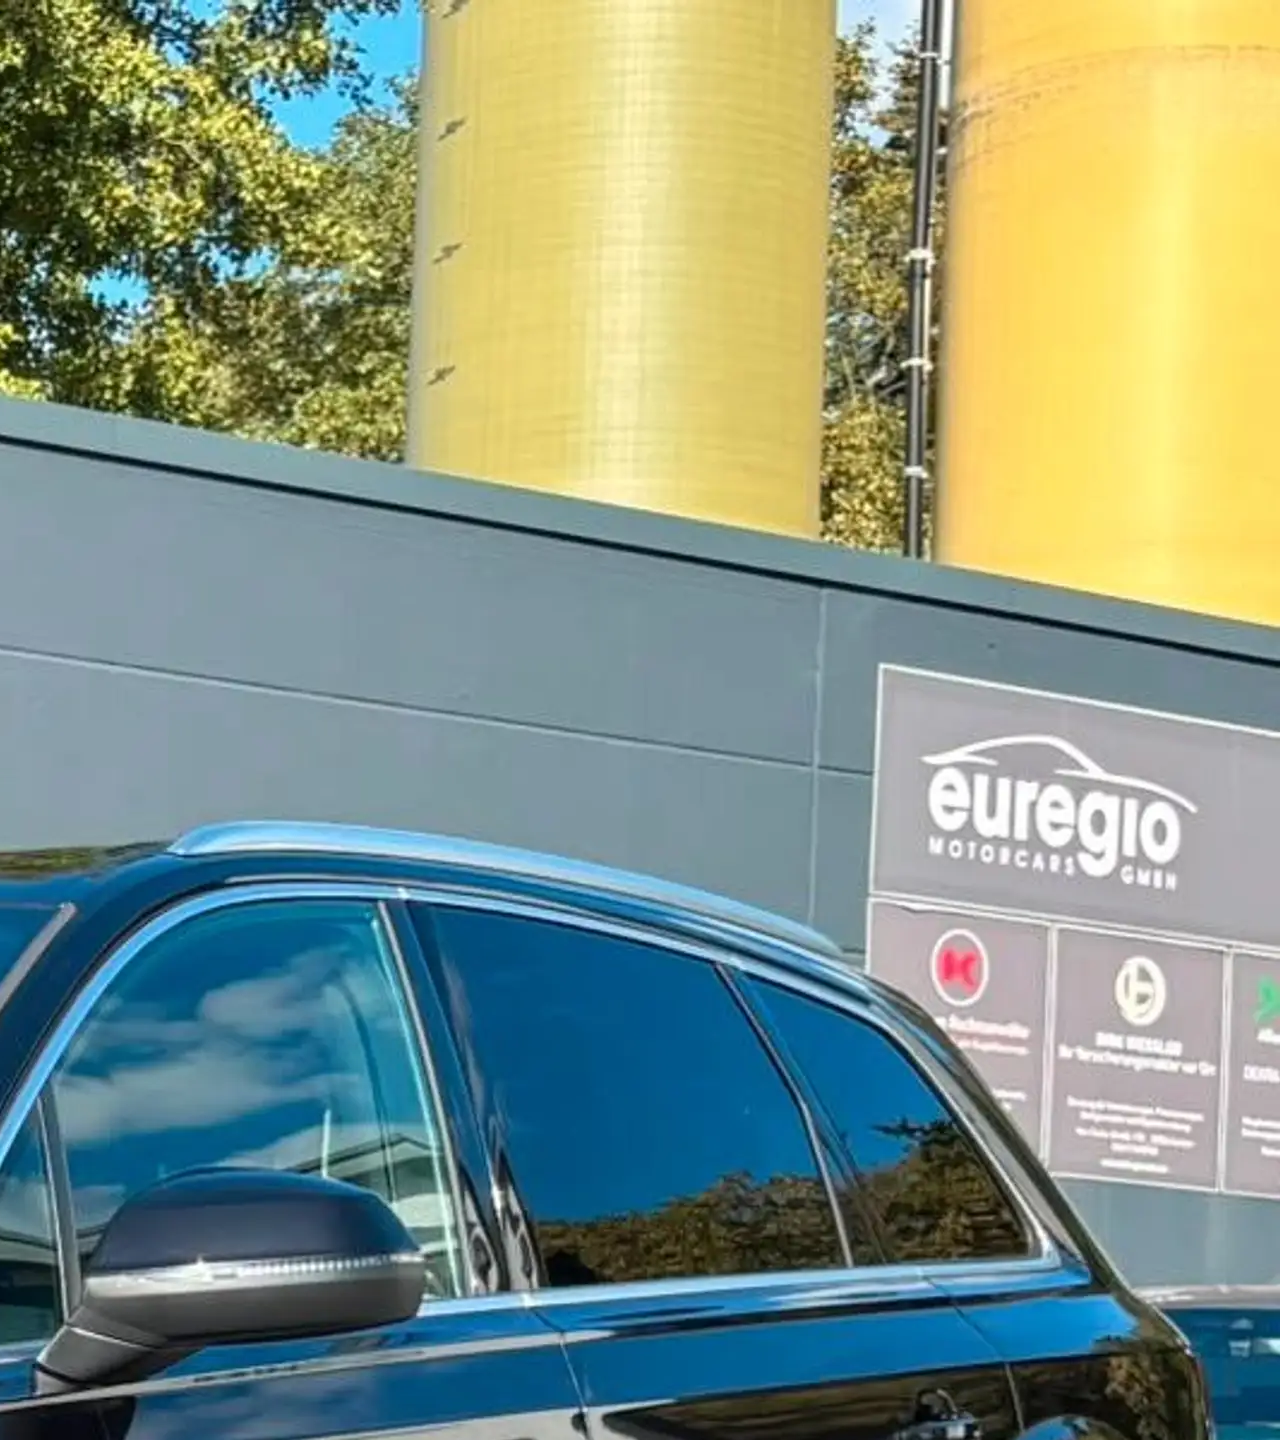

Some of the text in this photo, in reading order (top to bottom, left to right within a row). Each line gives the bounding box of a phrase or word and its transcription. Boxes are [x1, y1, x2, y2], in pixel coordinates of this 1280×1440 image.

[927, 766, 1181, 878] euregio
[928, 836, 1179, 891] MOTORCARS GMBH
